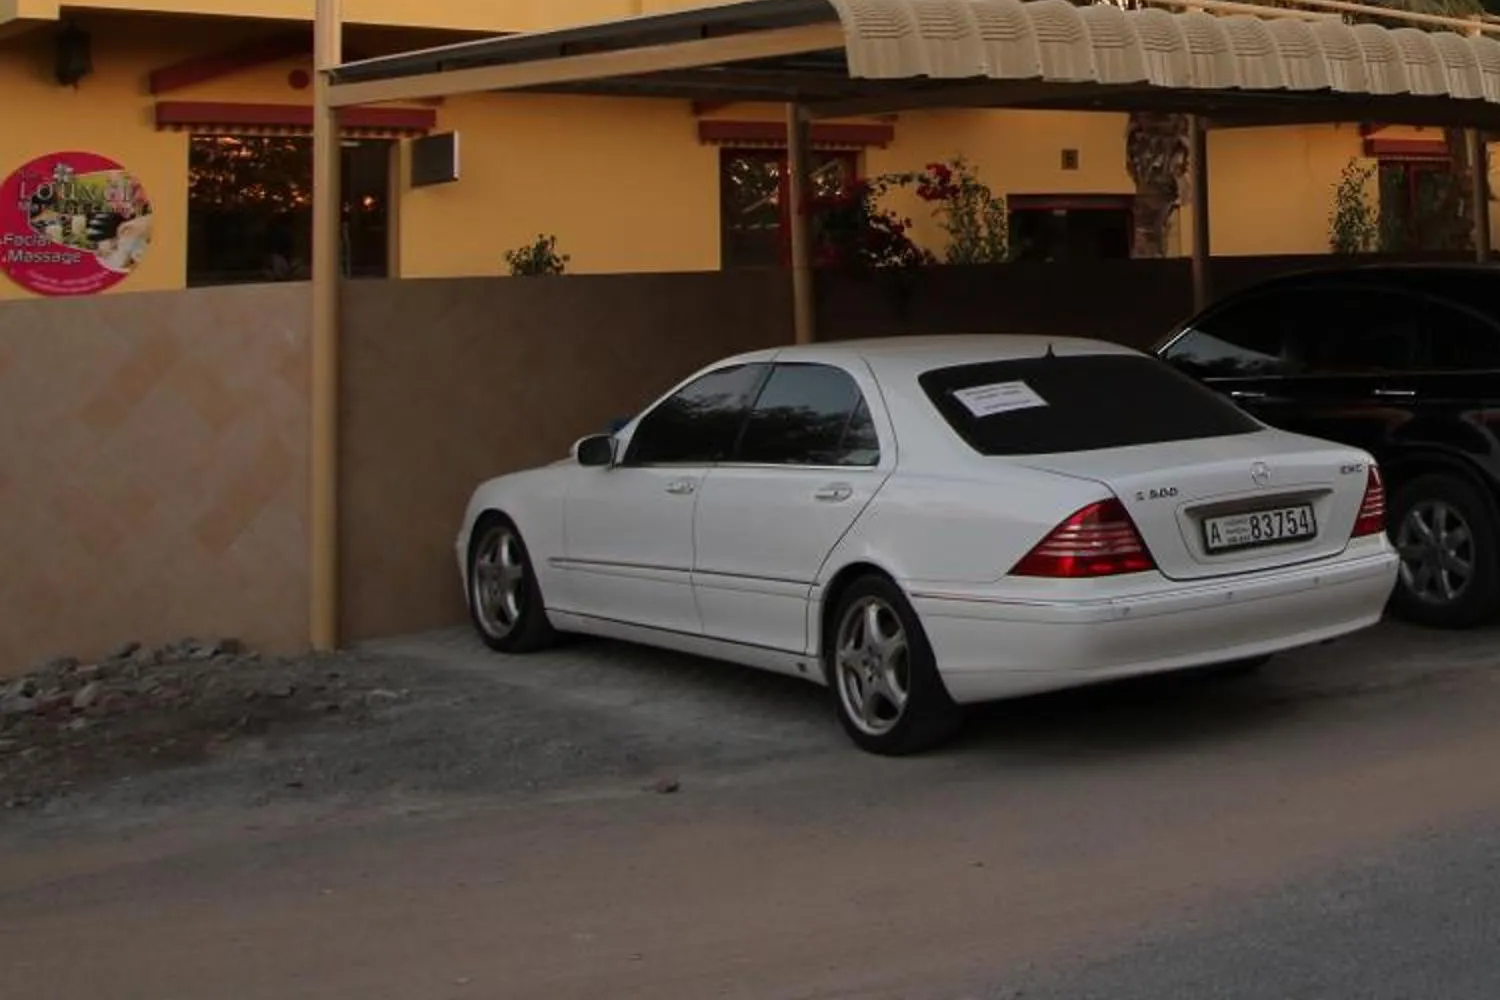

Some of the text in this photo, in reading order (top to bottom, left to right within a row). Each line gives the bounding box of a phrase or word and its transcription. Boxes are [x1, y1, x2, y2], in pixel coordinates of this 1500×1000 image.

[7, 249, 81, 264] Massage
[1210, 521, 1222, 545] A
[1249, 508, 1309, 540] 83754
